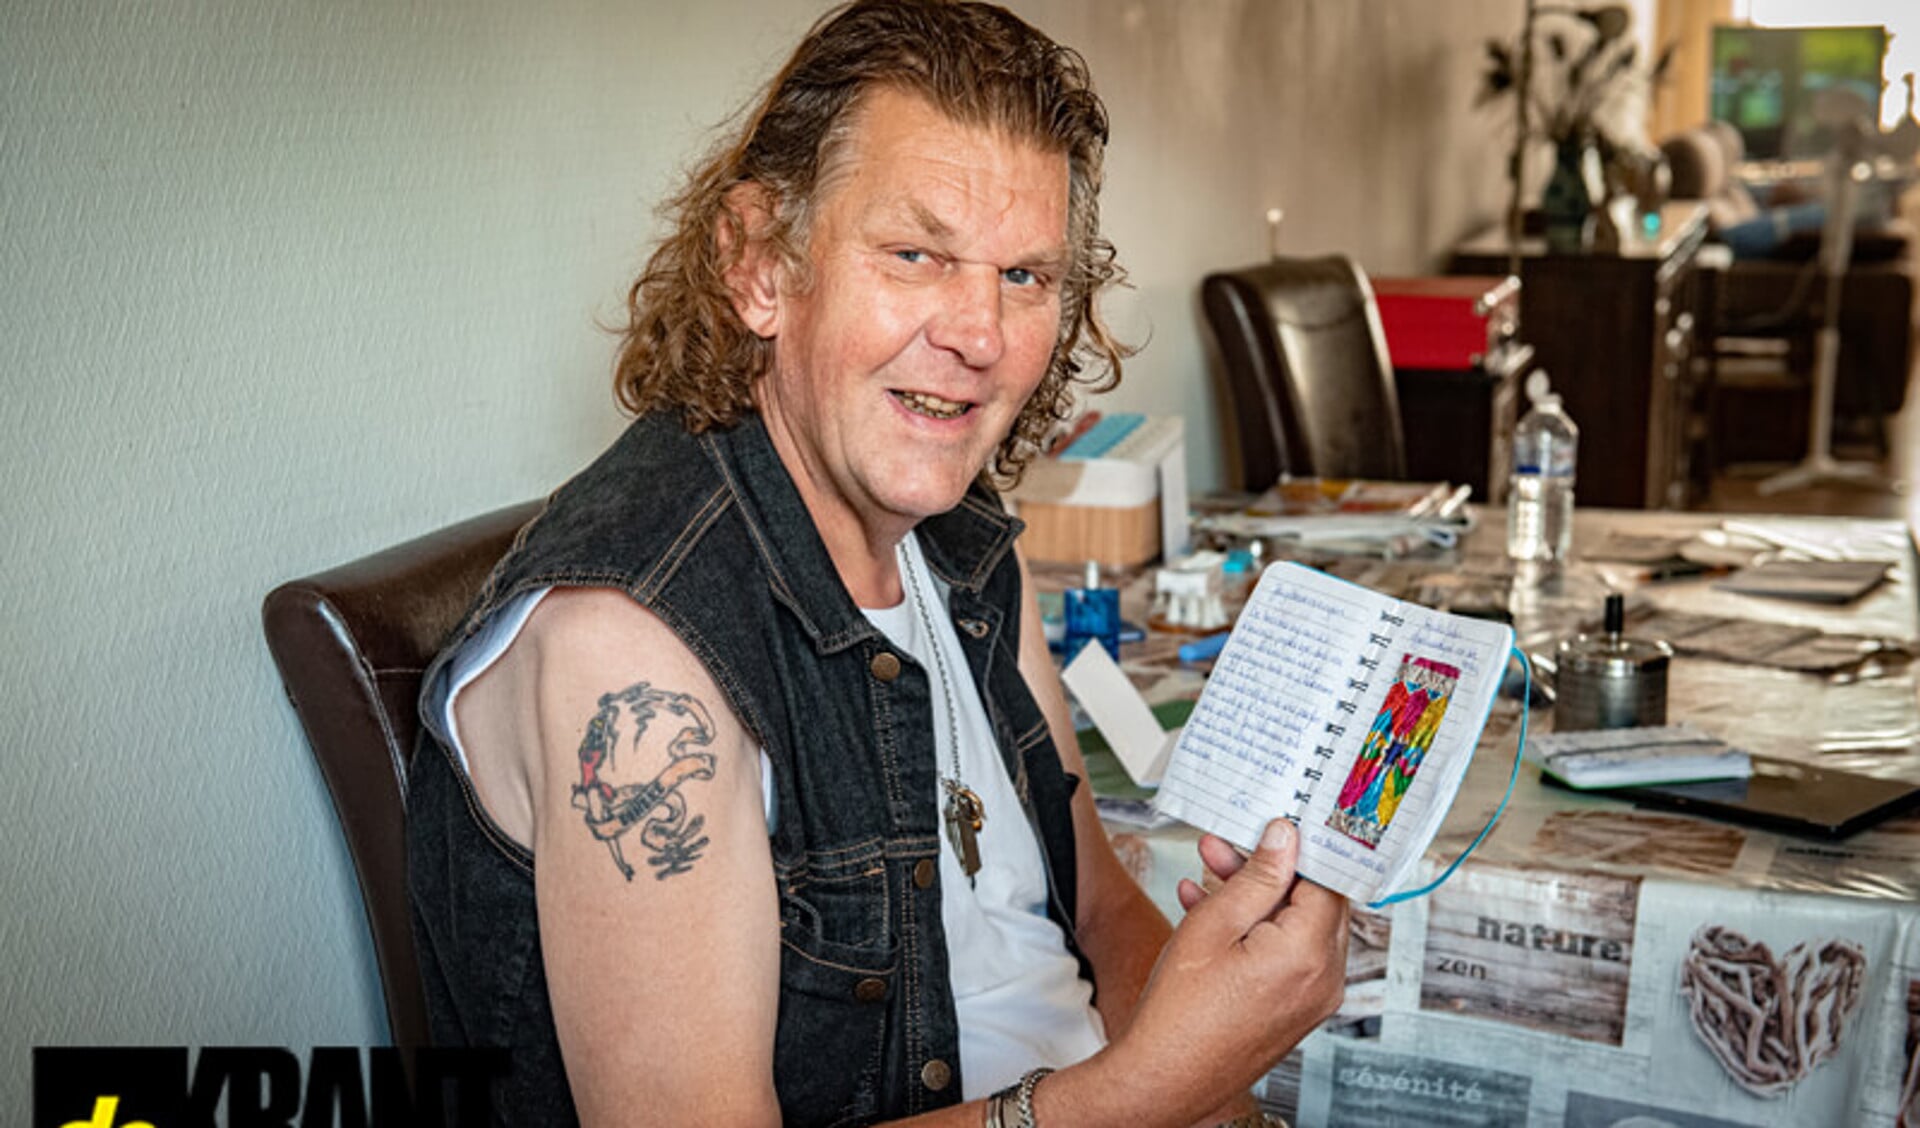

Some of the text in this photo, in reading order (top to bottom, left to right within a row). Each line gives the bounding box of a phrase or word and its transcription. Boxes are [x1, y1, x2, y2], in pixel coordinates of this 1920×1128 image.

[1477, 915, 1624, 961] nature
[1436, 956, 1487, 980] zen
[1338, 1065, 1482, 1103] sérénité
